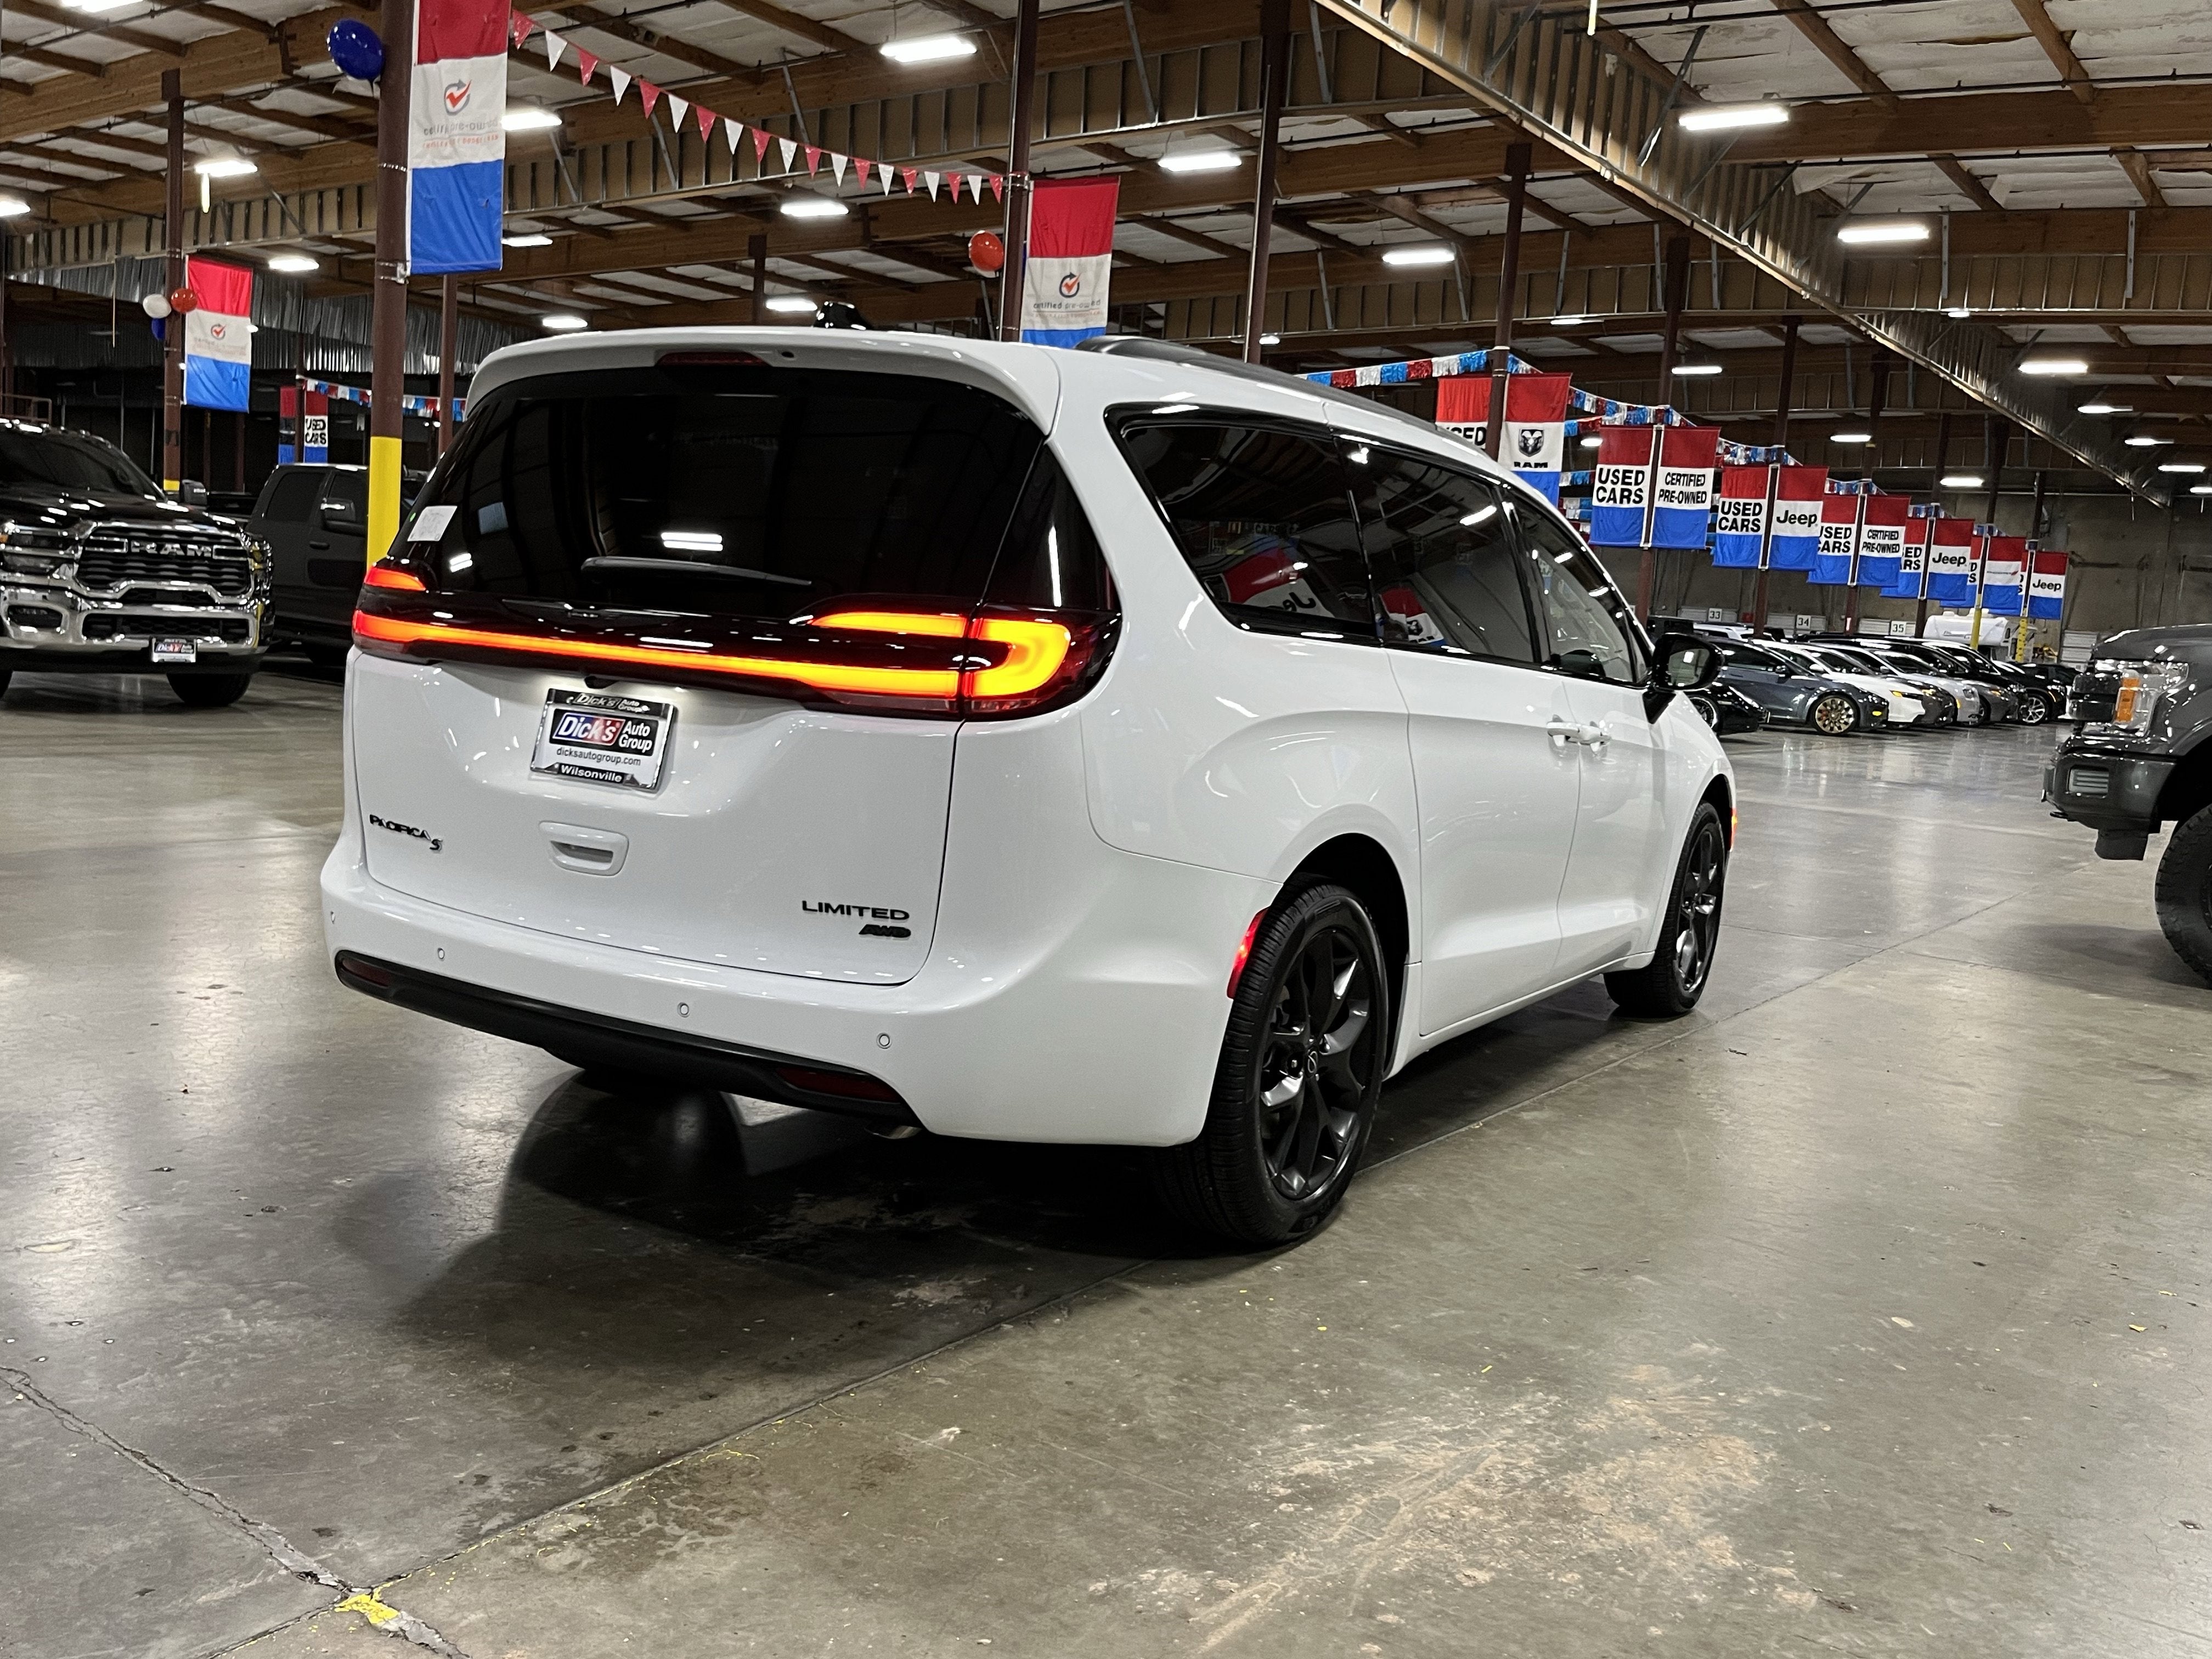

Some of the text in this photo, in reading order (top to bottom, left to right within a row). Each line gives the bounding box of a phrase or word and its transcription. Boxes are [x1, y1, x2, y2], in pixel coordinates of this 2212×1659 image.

[306, 418, 326, 431] USED
[1598, 468, 1645, 486] USED
[1665, 472, 1706, 487] CERTIFIED
[1596, 486, 1643, 504] CARS
[1658, 489, 1707, 504] PRE-OWNED
[1720, 501, 1763, 516] USED
[1718, 517, 1760, 532] CARS
[1776, 510, 1817, 527] Jeep
[1867, 529, 1899, 540] CERTIFIED
[131, 540, 211, 557] RAM
[1862, 541, 1900, 553] PRE-OWNED
[1932, 552, 1966, 567] Jeep
[2033, 579, 2061, 591] Jeep
[1709, 611, 1720, 619] 33
[1798, 618, 1809, 626] 34
[558, 716, 616, 741] Dick's
[622, 721, 651, 737] Auto
[619, 734, 653, 753] Group
[556, 747, 641, 766] dicksautogroup.com
[561, 765, 623, 782] Wilsonville
[802, 900, 910, 920] LIMITED
[858, 924, 912, 938] AWD
